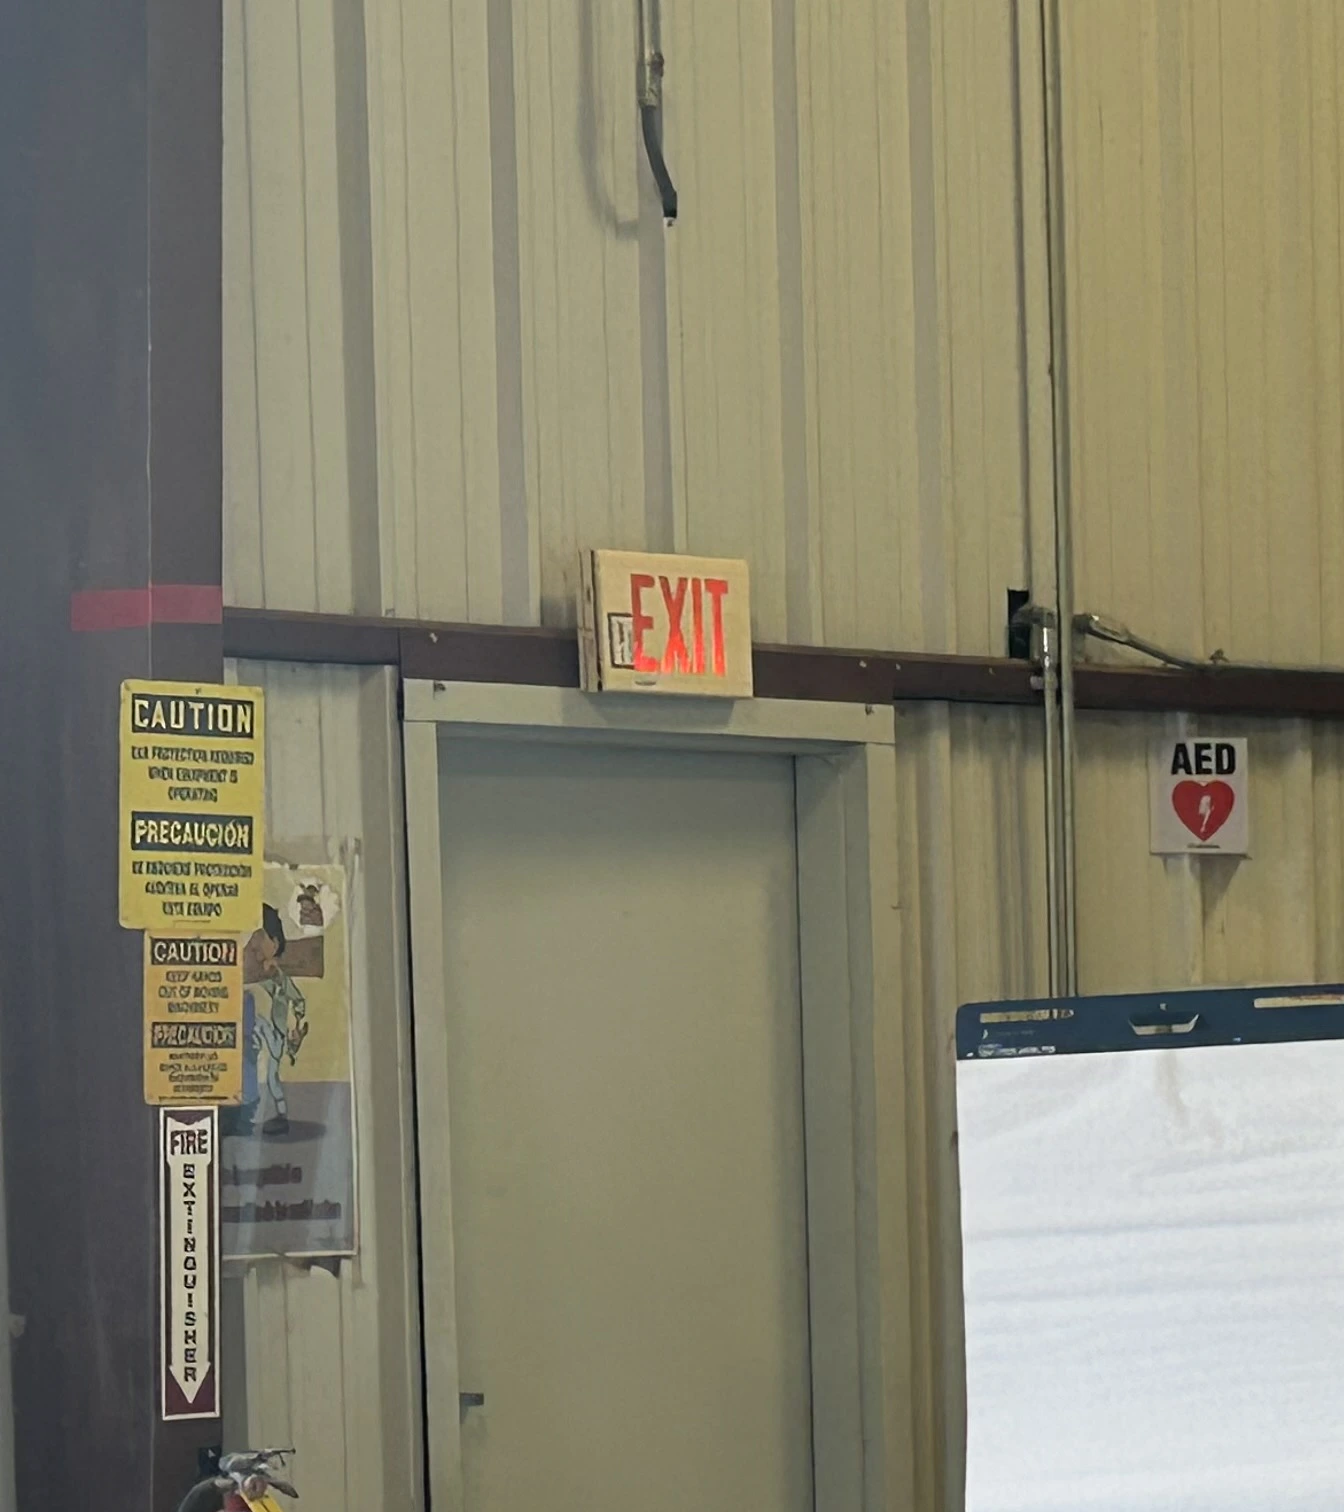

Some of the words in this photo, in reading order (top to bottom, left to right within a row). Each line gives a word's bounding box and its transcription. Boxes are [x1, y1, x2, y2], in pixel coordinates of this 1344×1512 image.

[630, 573, 728, 677] EXIT
[133, 698, 251, 734] CAUTION
[1171, 742, 1236, 775] AED
[153, 941, 235, 962] CAUTION
[170, 1128, 208, 1156] FIRE
[183, 1163, 197, 1382] EXTINGUISHER
